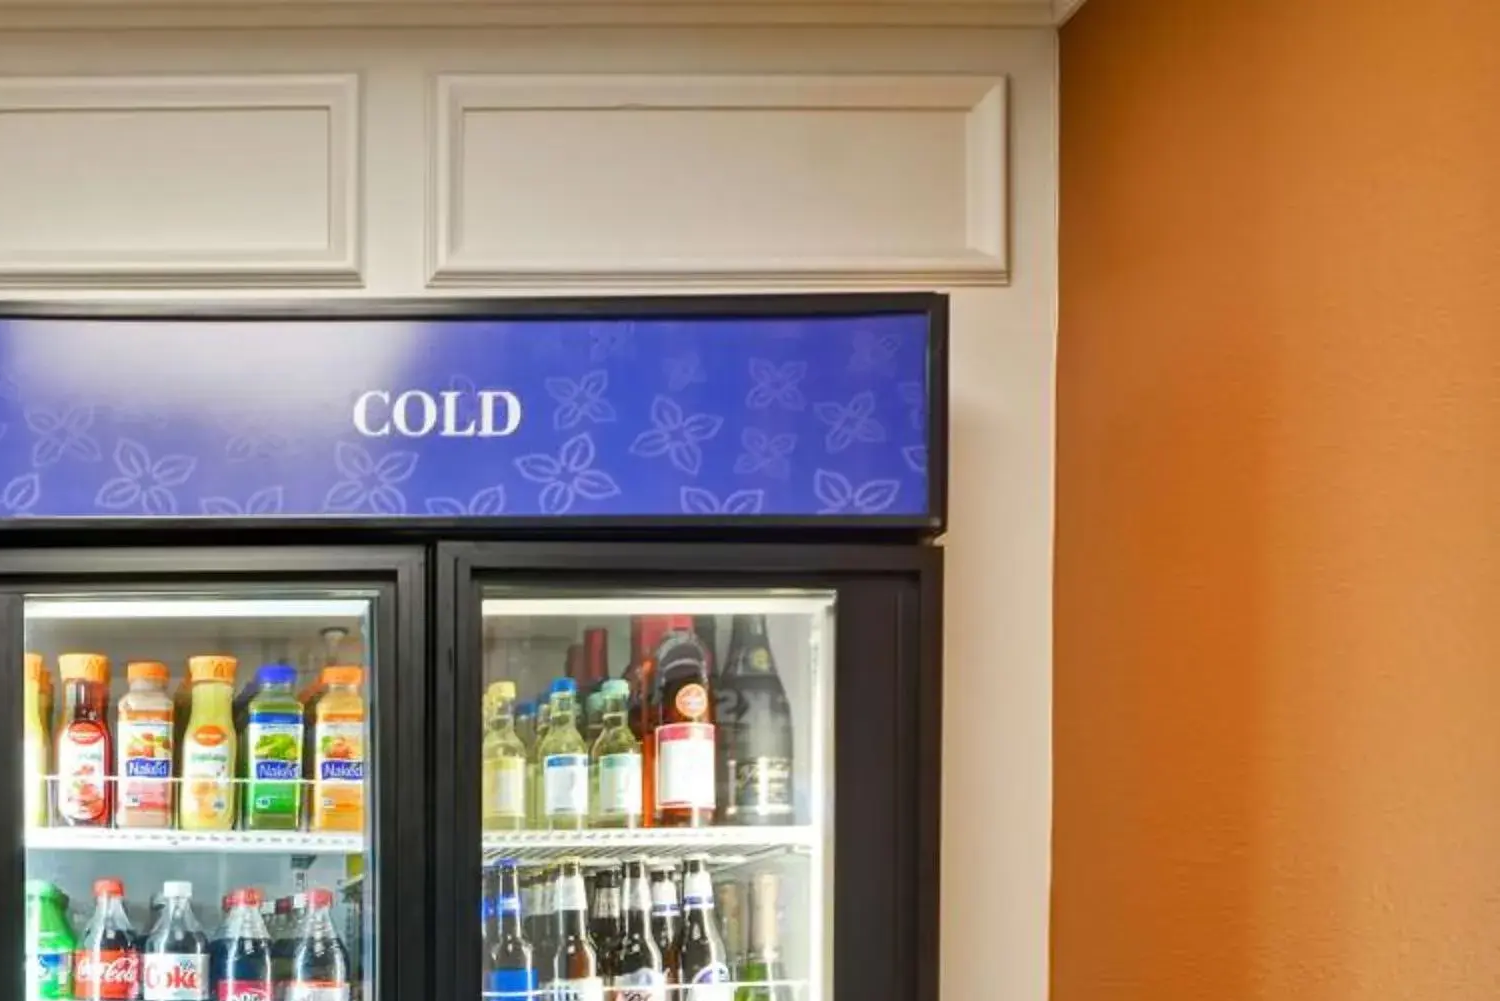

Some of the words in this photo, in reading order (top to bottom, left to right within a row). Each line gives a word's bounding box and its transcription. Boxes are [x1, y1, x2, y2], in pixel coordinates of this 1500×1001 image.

[353, 390, 521, 437] COLD
[129, 759, 168, 777] Naked
[259, 763, 299, 778] Naked
[323, 763, 362, 778] Naked
[76, 957, 136, 982] CCola
